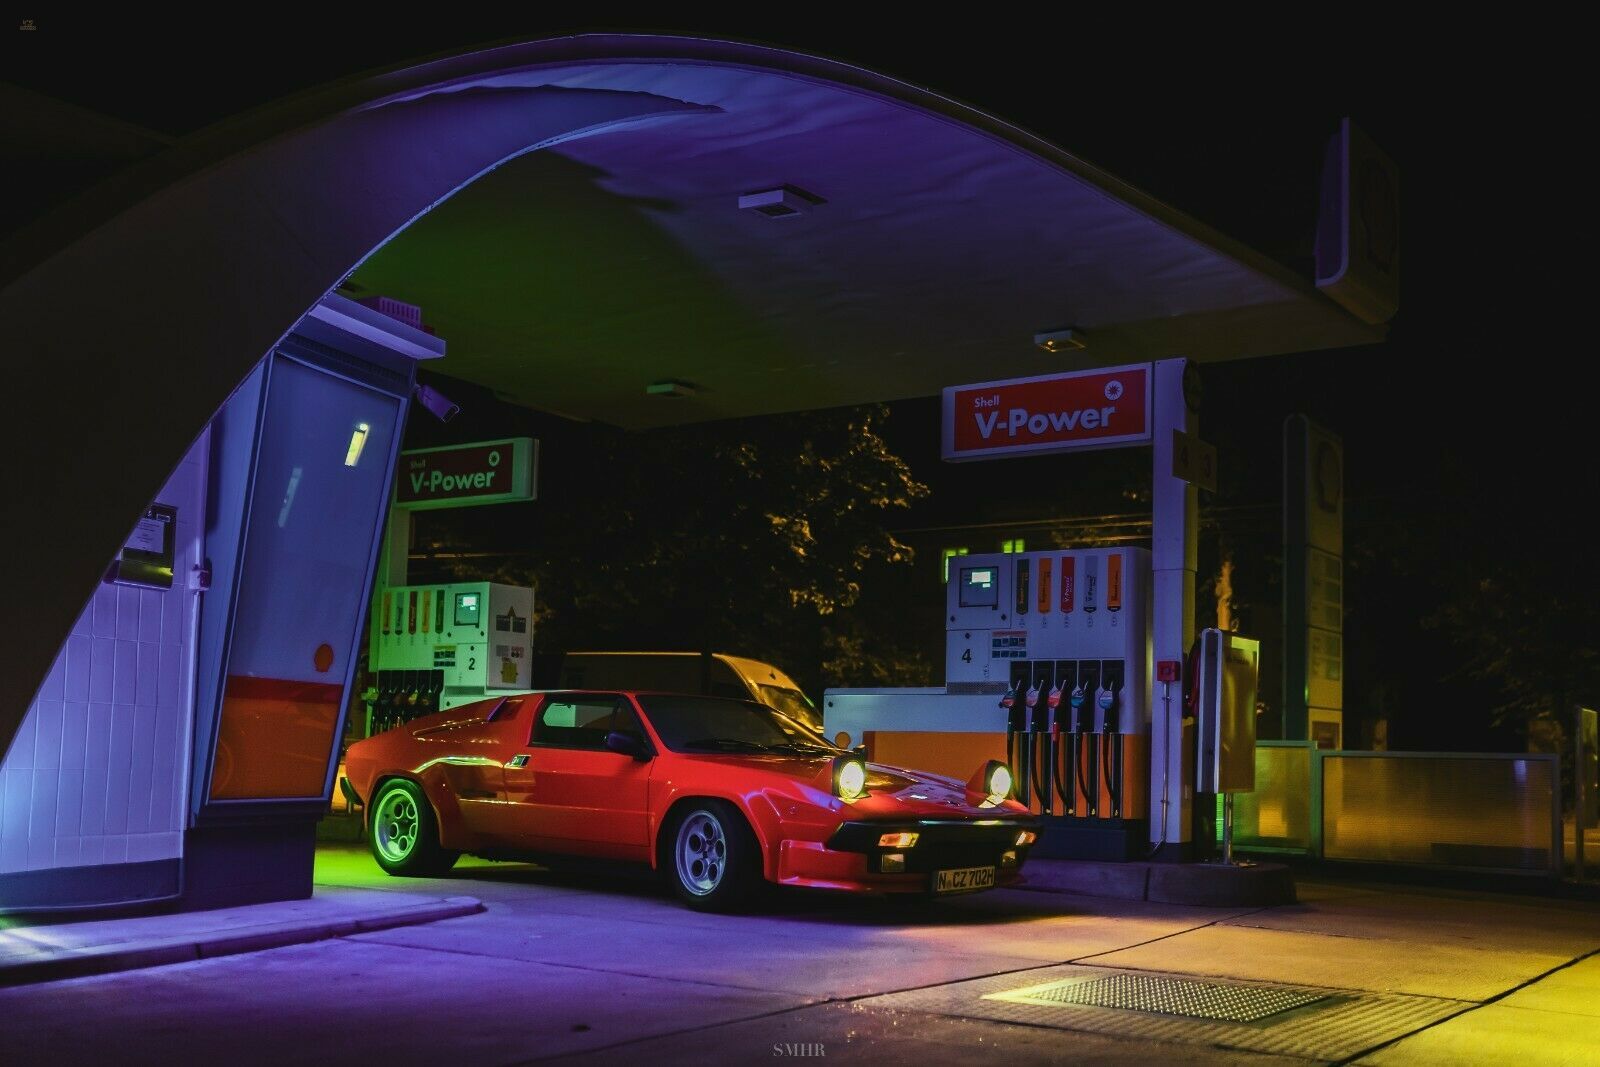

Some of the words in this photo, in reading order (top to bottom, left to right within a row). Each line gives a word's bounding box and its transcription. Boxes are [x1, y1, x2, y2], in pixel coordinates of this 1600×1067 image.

[974, 394, 1000, 408] Shell
[974, 405, 1116, 439] V-Power
[410, 470, 496, 495] V-Power
[468, 657, 476, 671] 2
[962, 648, 972, 664] 4
[939, 871, 947, 889] N
